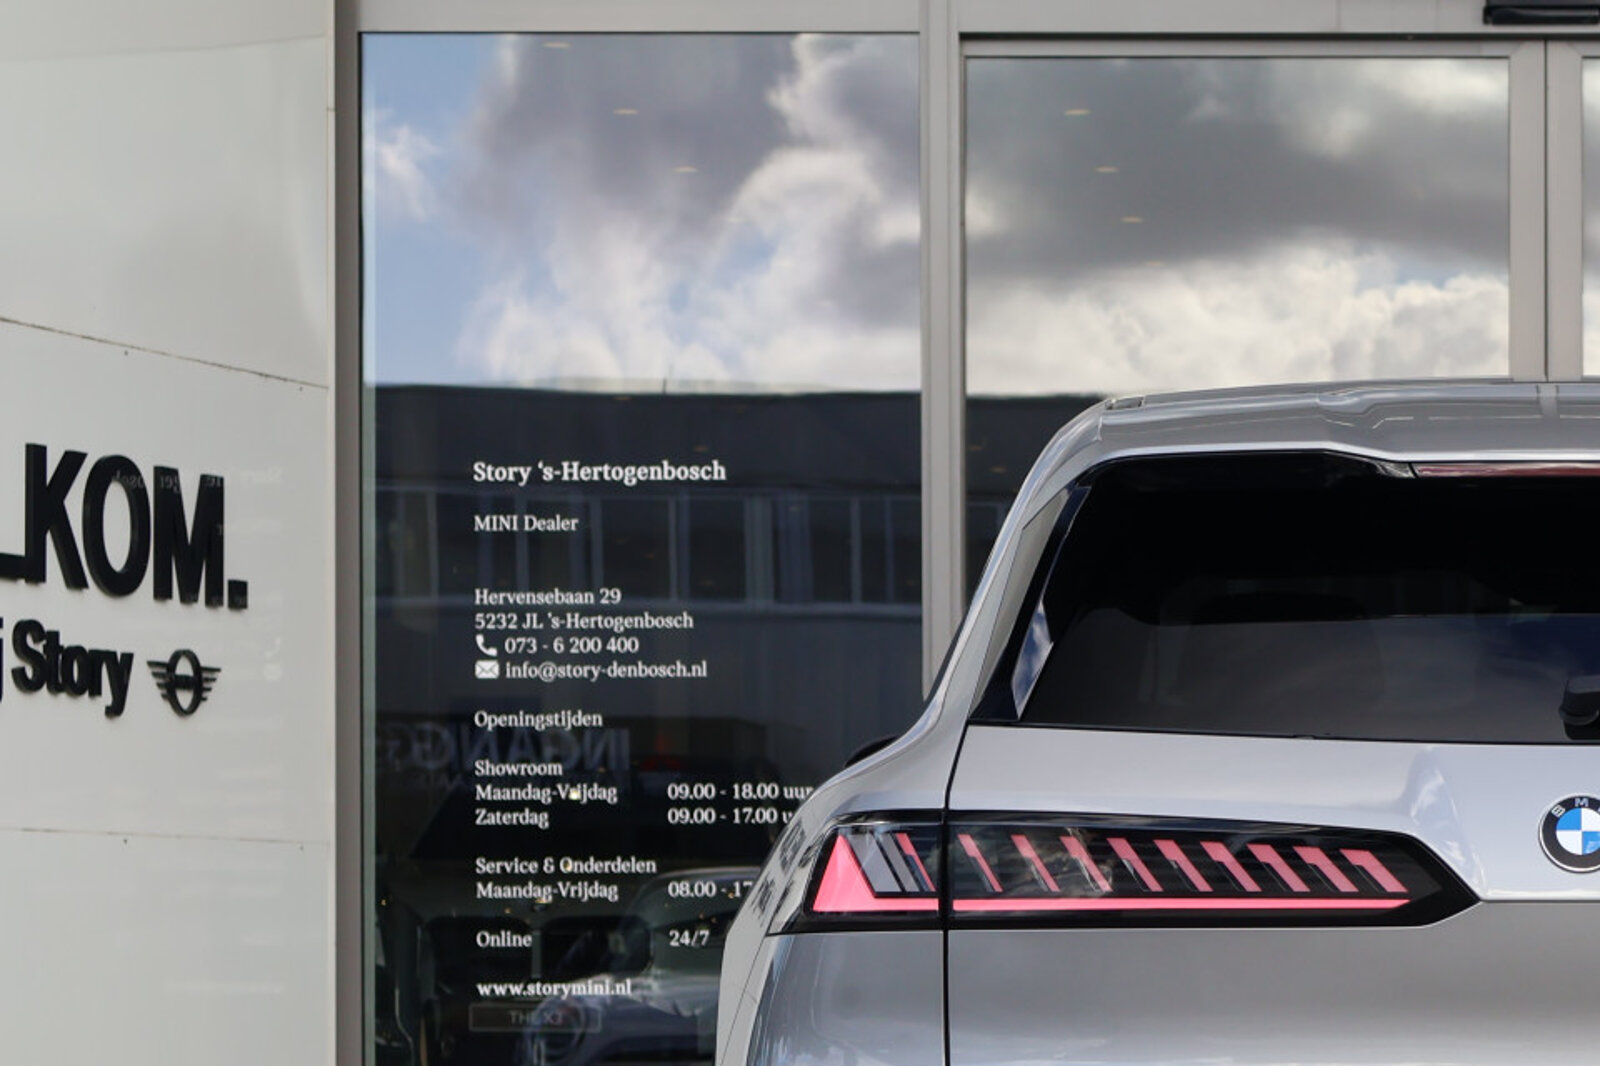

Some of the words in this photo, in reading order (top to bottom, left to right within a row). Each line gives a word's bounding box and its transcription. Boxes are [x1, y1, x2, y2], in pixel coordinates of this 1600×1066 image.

[473, 461, 532, 487] Story
[0, 443, 248, 610] KOM.
[474, 514, 519, 532] MINI
[523, 514, 579, 532] Dealer
[474, 587, 595, 605] Hervensebaan
[599, 588, 622, 605] 29
[475, 612, 518, 630] 5232
[521, 612, 544, 629] JL
[504, 636, 538, 654] 073
[552, 636, 565, 654] 6
[569, 636, 603, 654] 200
[606, 636, 640, 654] 400
[11, 619, 134, 718] Story
[505, 660, 708, 683] info@story-denbosch.nl
[474, 709, 603, 732] Openingstijden
[474, 759, 563, 777] Showroom
[475, 782, 618, 805] Maandag-Vrijdag
[667, 783, 716, 800] 09.00
[733, 783, 780, 800] 18.00
[475, 807, 550, 829] Zaterdag
[667, 807, 717, 824] 09.00
[733, 807, 779, 824] 17.00
[475, 857, 539, 874] Service
[542, 857, 555, 874] &
[559, 856, 657, 874] Onderdelen
[476, 880, 619, 903] Maandag-Vrijdag
[667, 880, 717, 898] 08.00
[476, 930, 533, 947] Online
[669, 929, 710, 947] 24/7
[477, 978, 633, 999] www.storymini.nl
